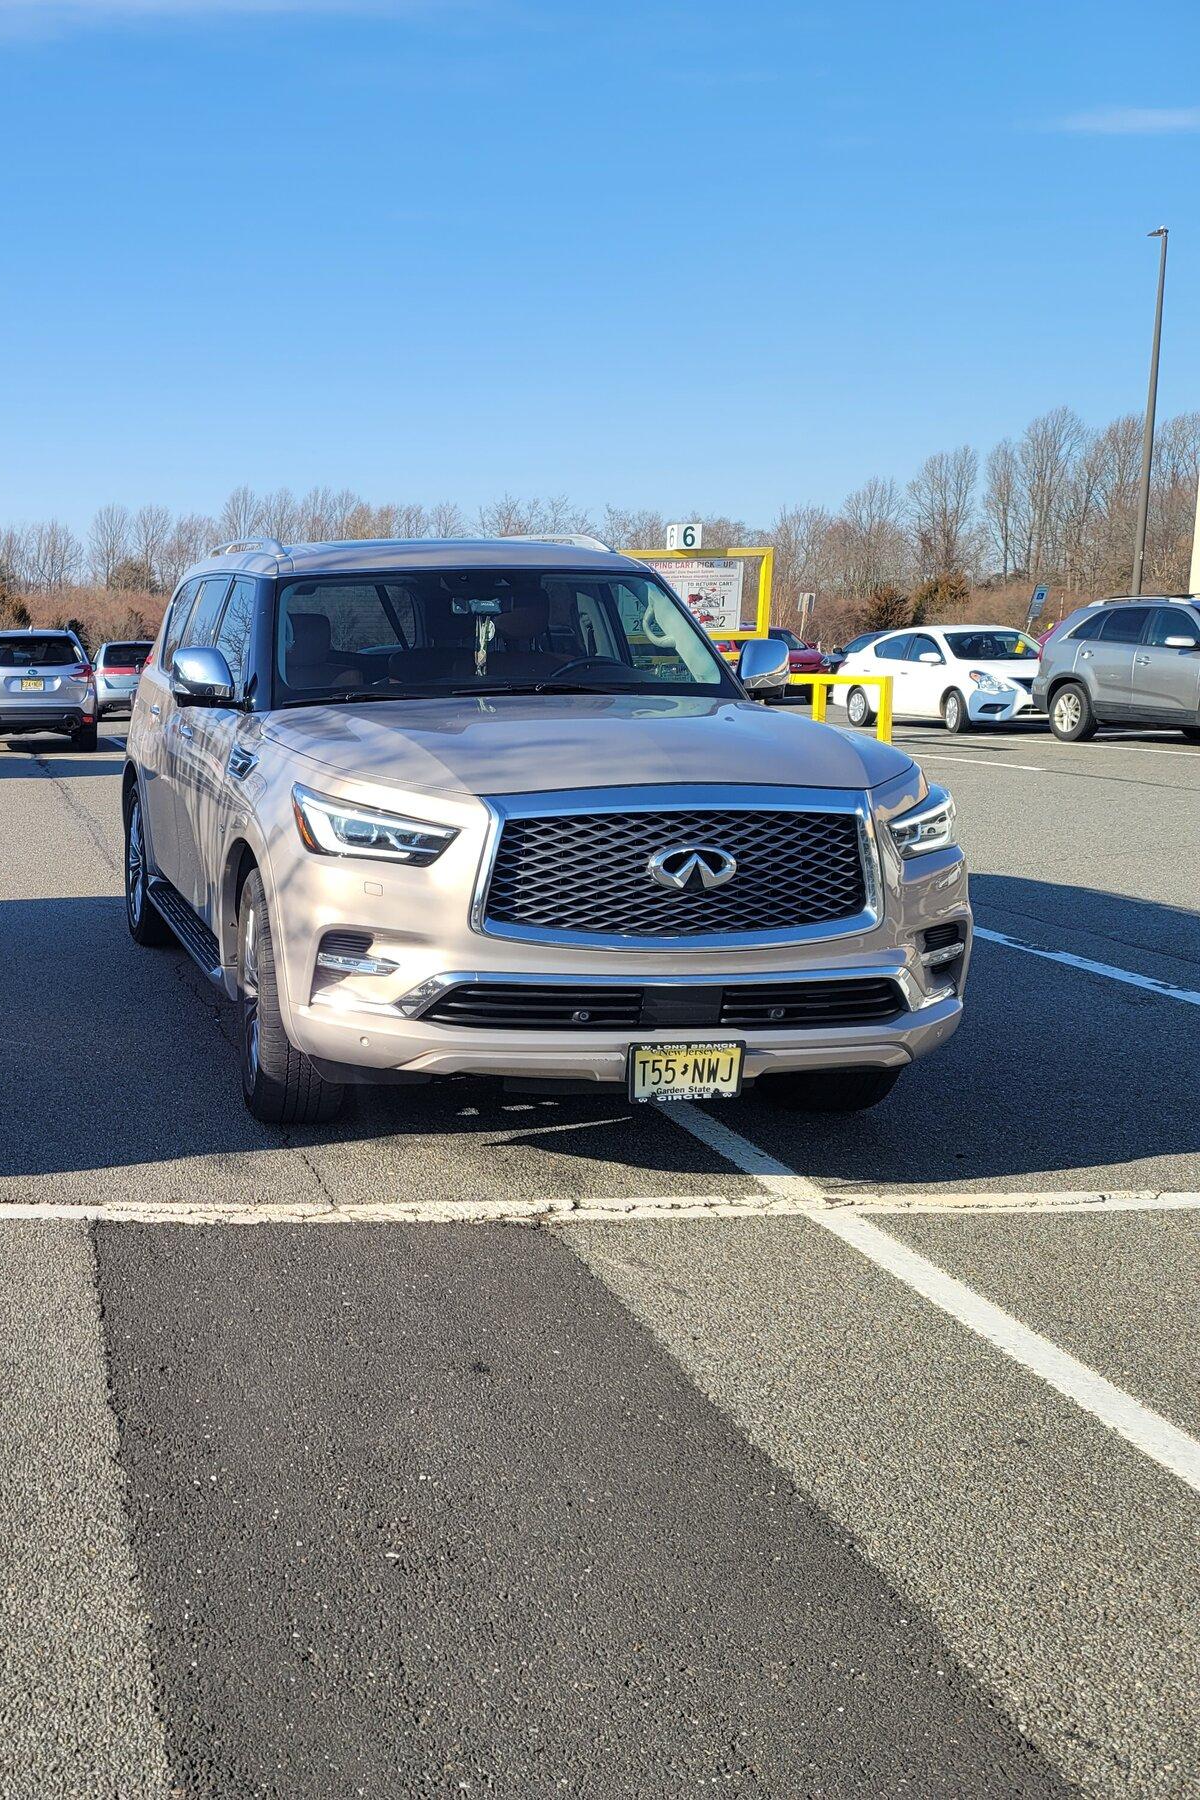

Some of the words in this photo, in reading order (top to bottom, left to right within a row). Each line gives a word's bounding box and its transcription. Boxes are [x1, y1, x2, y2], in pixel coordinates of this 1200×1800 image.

[670, 527, 675, 547] 6
[683, 526, 696, 547] 6
[675, 561, 694, 569] CART
[720, 595, 725, 607] 1
[632, 619, 639, 631] 2
[719, 615, 726, 627] 2
[660, 1049, 682, 1057] New
[684, 1048, 715, 1057] Jersey
[639, 1059, 677, 1087] T55
[692, 1057, 734, 1083] NWJ
[656, 1086, 685, 1095] Garden
[688, 1085, 711, 1093] State
[657, 1093, 712, 1102] CIRCLE
